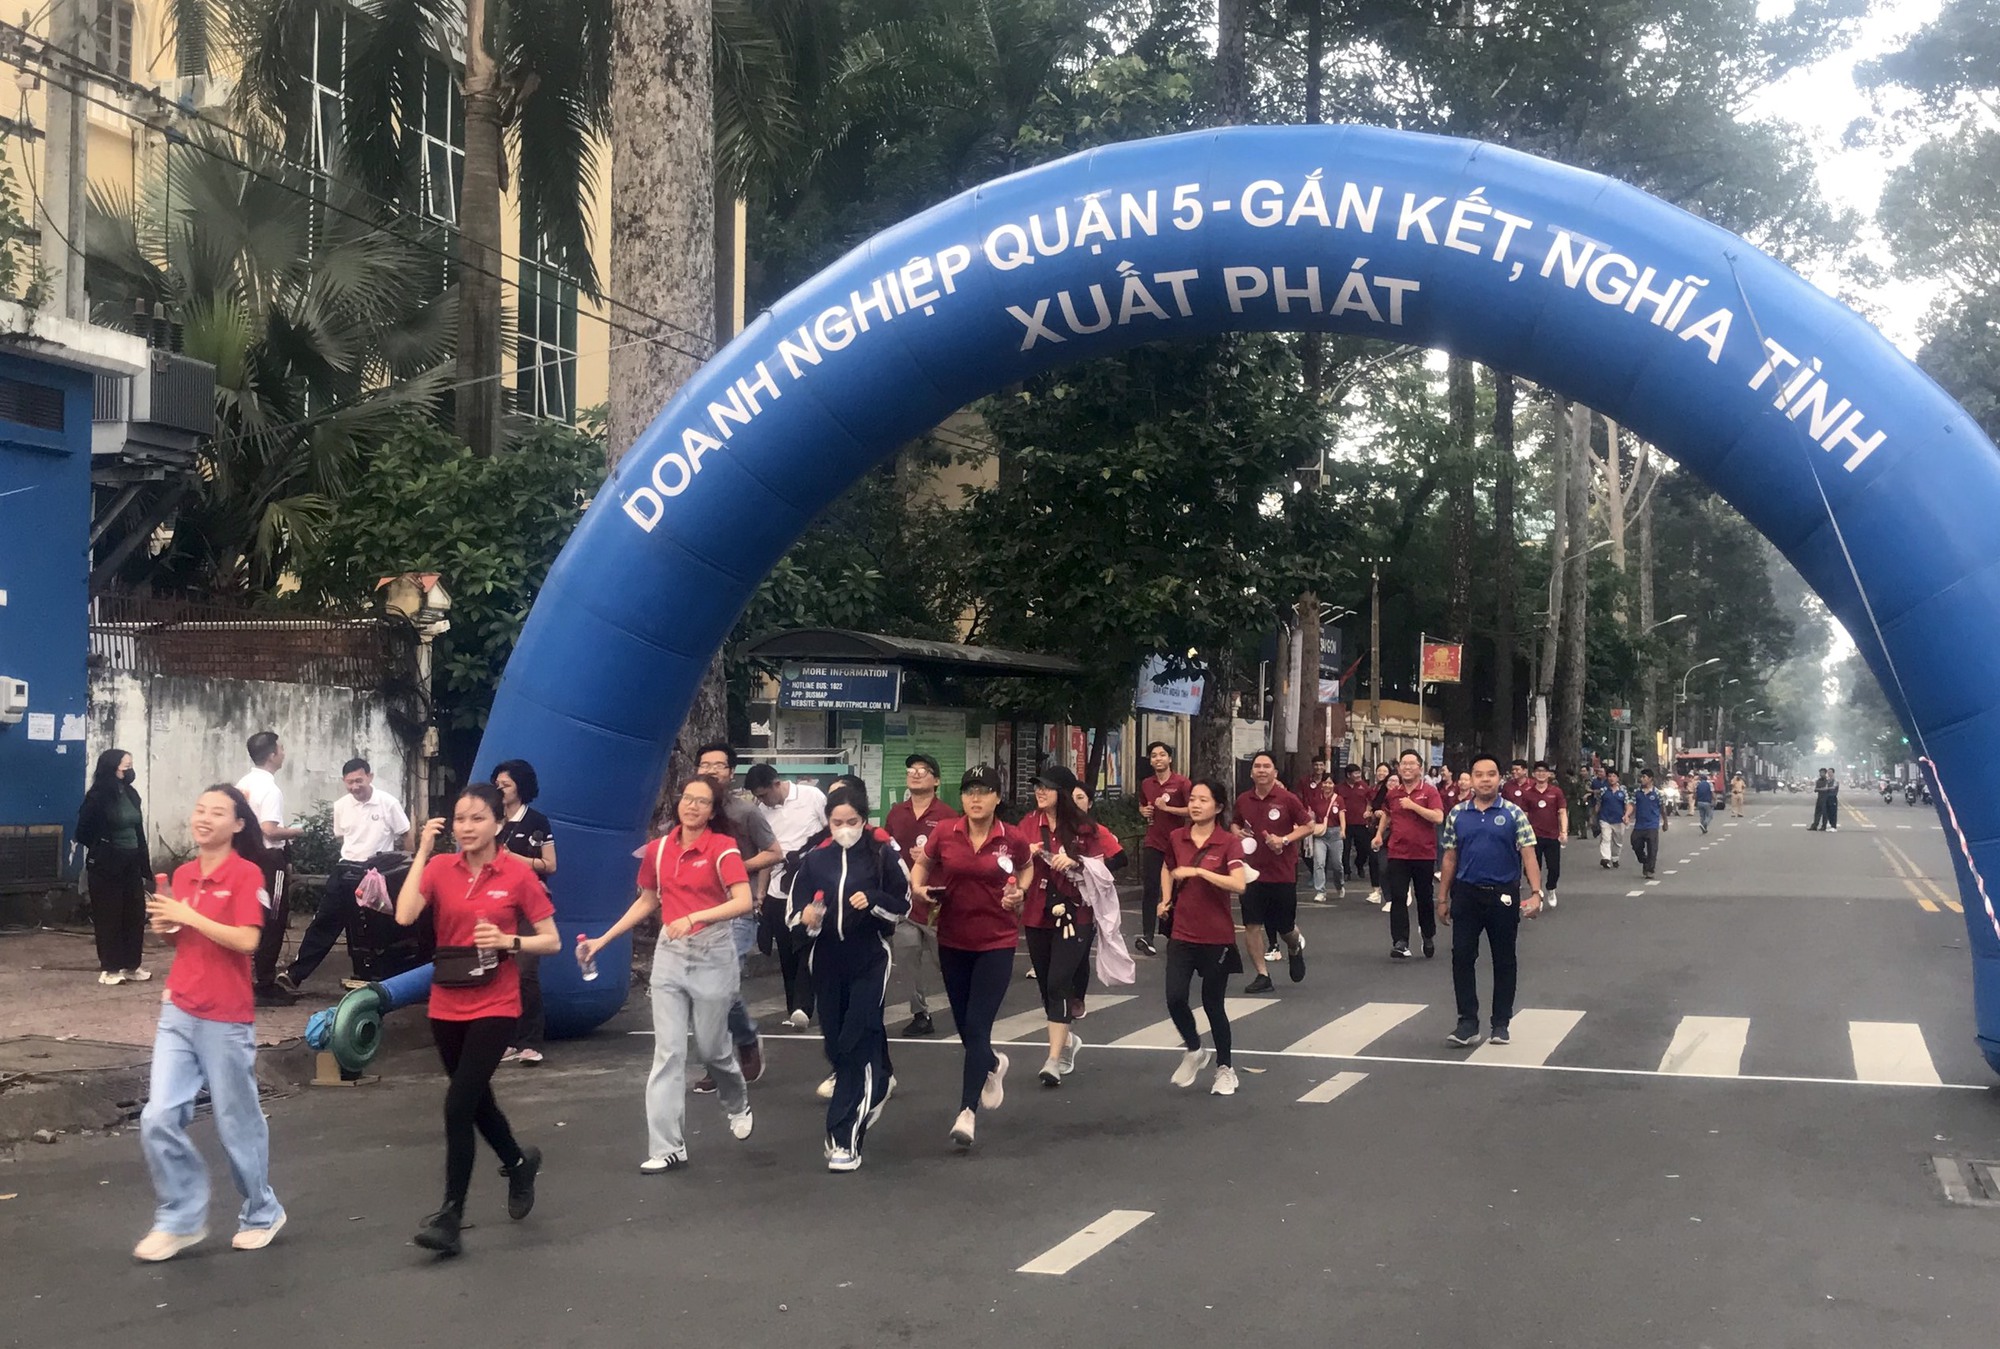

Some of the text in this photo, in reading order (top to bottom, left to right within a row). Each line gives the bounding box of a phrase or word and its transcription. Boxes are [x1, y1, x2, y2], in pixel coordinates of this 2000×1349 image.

[1005, 257, 1420, 351] XUẤT PHÁT
[622, 361, 782, 533] DOANH
[778, 244, 971, 378] NGHIỆP
[987, 191, 1158, 272] QUẬN
[1173, 183, 1204, 231] 5
[1240, 167, 1383, 234] GẮN
[1397, 187, 1534, 282] KẾT,
[1541, 229, 1735, 364] NGHĨA
[1748, 337, 1888, 473] TÌNH
[802, 667, 889, 678] MORE INFORMATION
[791, 681, 815, 689] HOTLINE
[790, 691, 803, 699] APP:
[805, 691, 828, 699] BUSMAP
[790, 700, 817, 708] WEBSITE:
